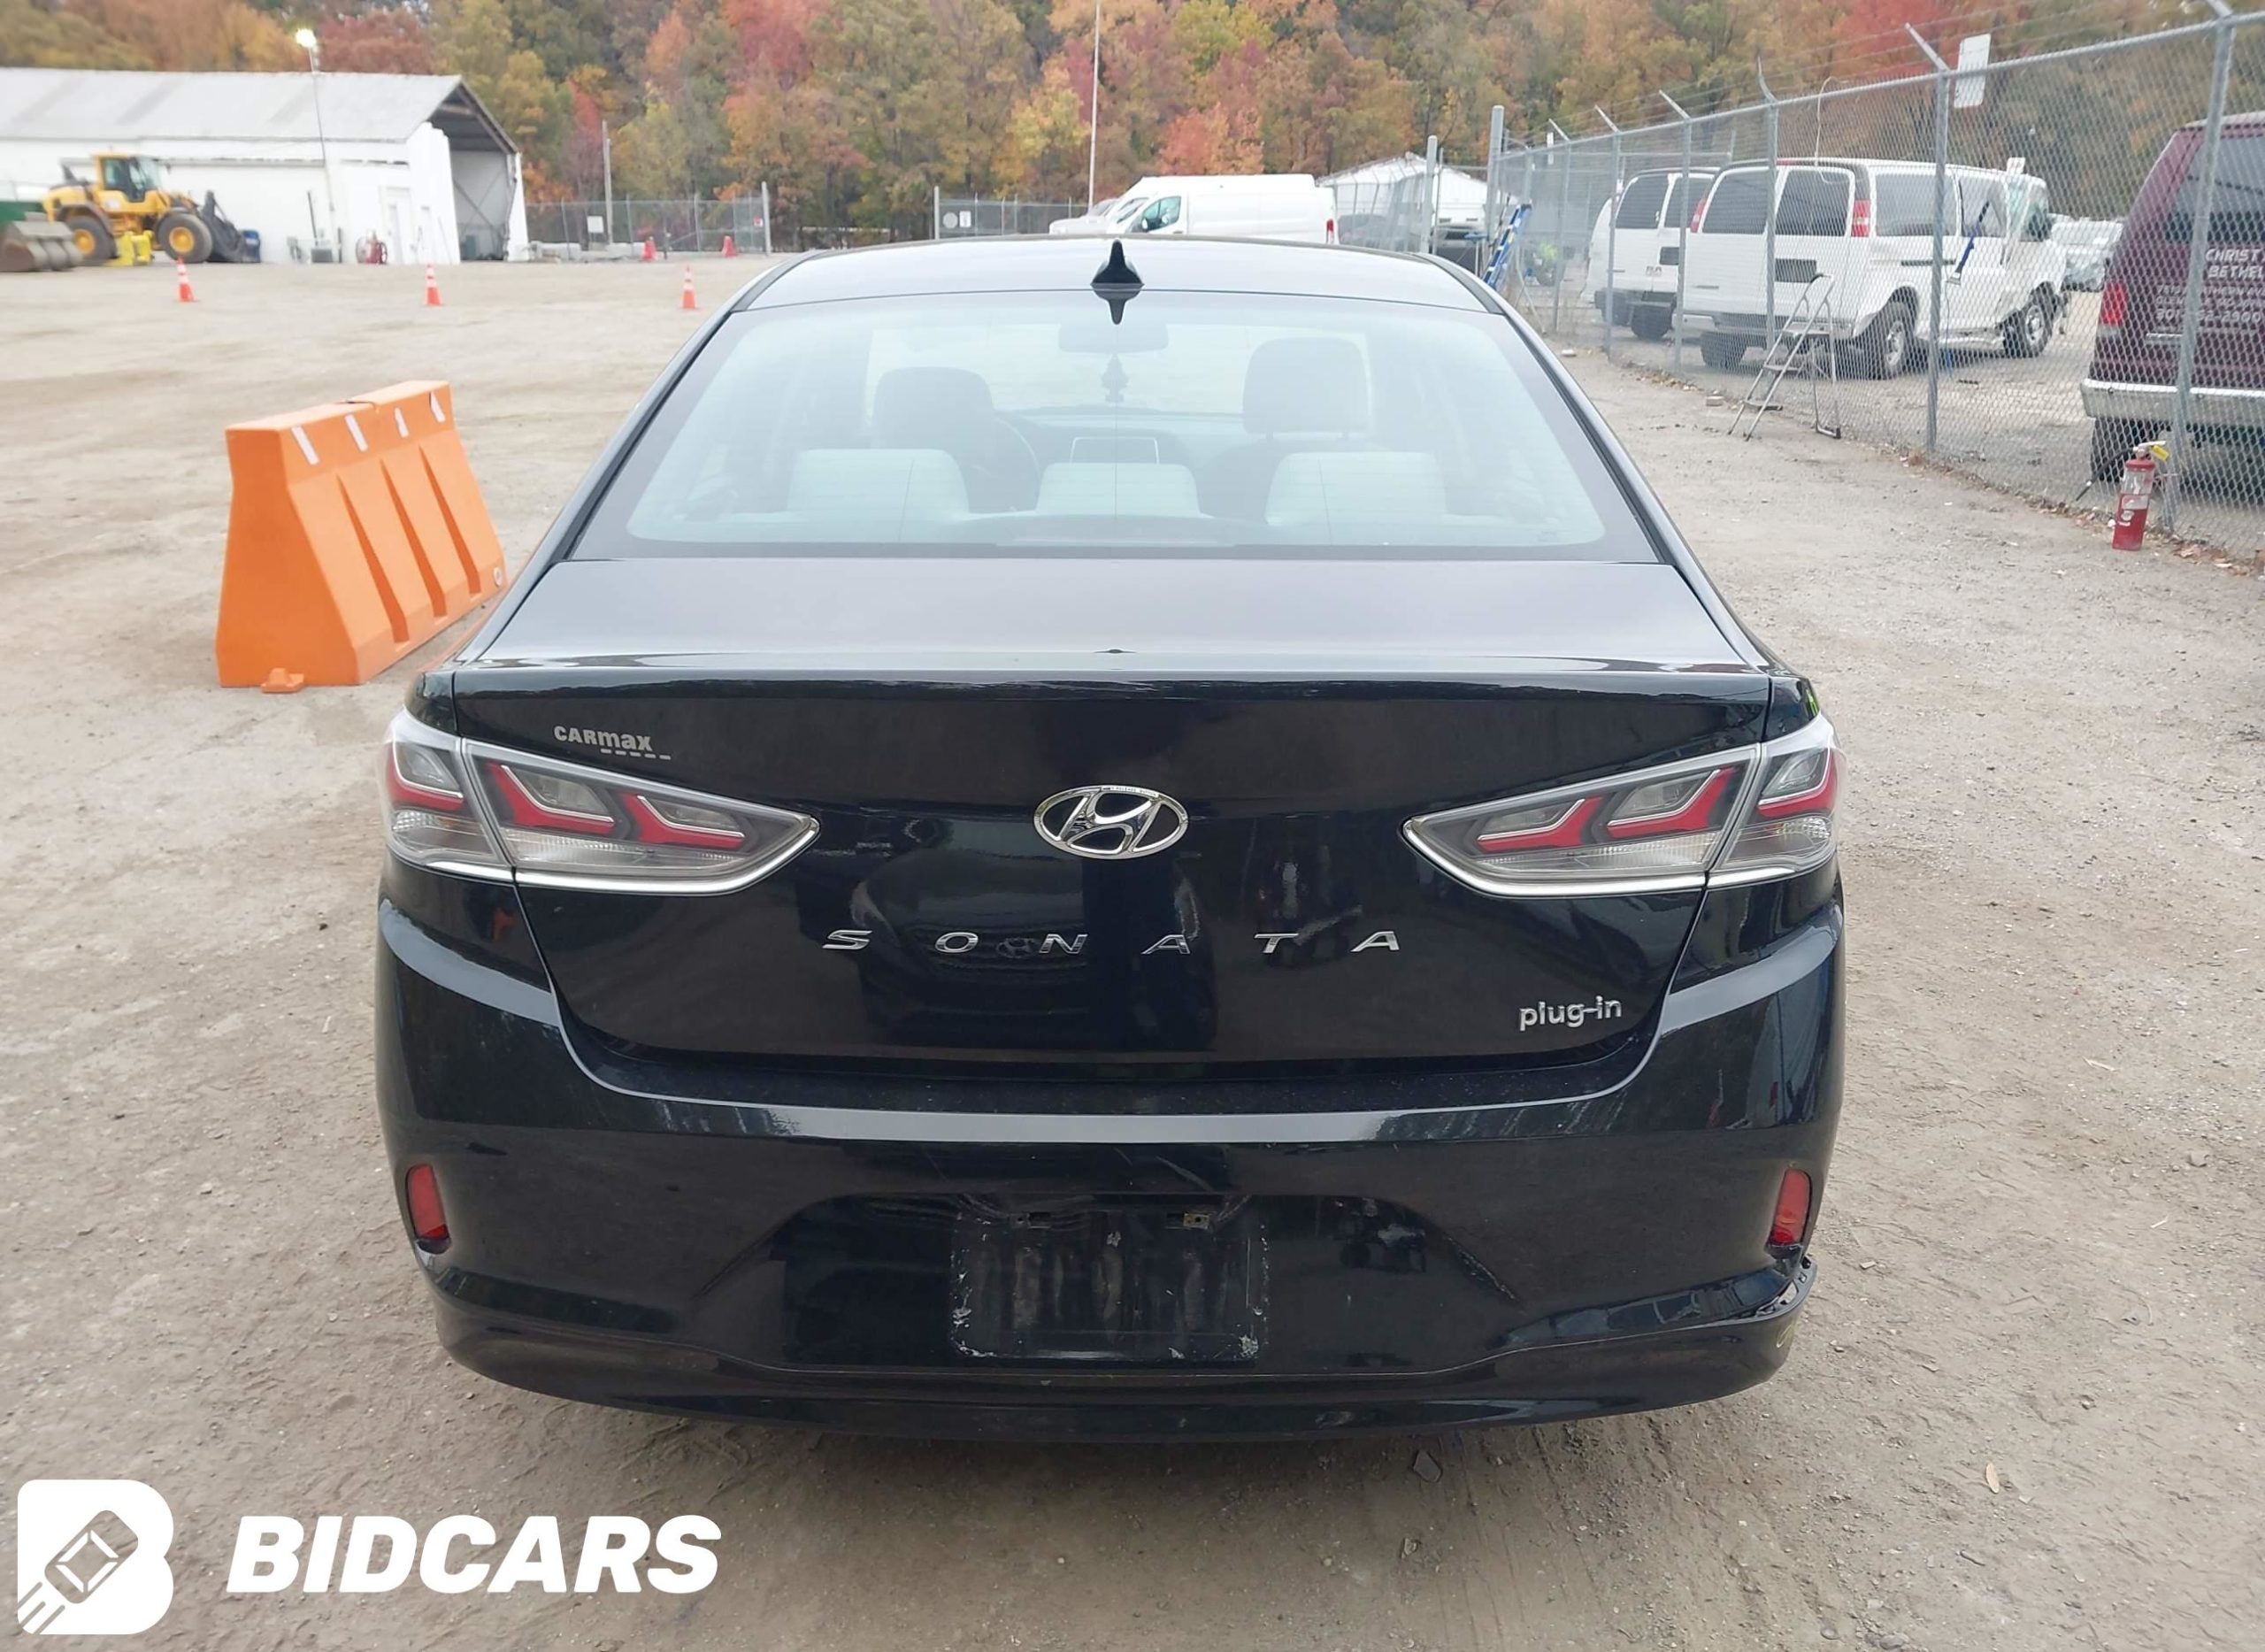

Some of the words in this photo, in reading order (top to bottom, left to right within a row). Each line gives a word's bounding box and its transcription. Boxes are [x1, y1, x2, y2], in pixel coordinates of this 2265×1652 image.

[2205, 249, 2261, 263] CHRIST
[822, 929, 1401, 955] SONATA
[1519, 995, 1622, 1032] plug-in
